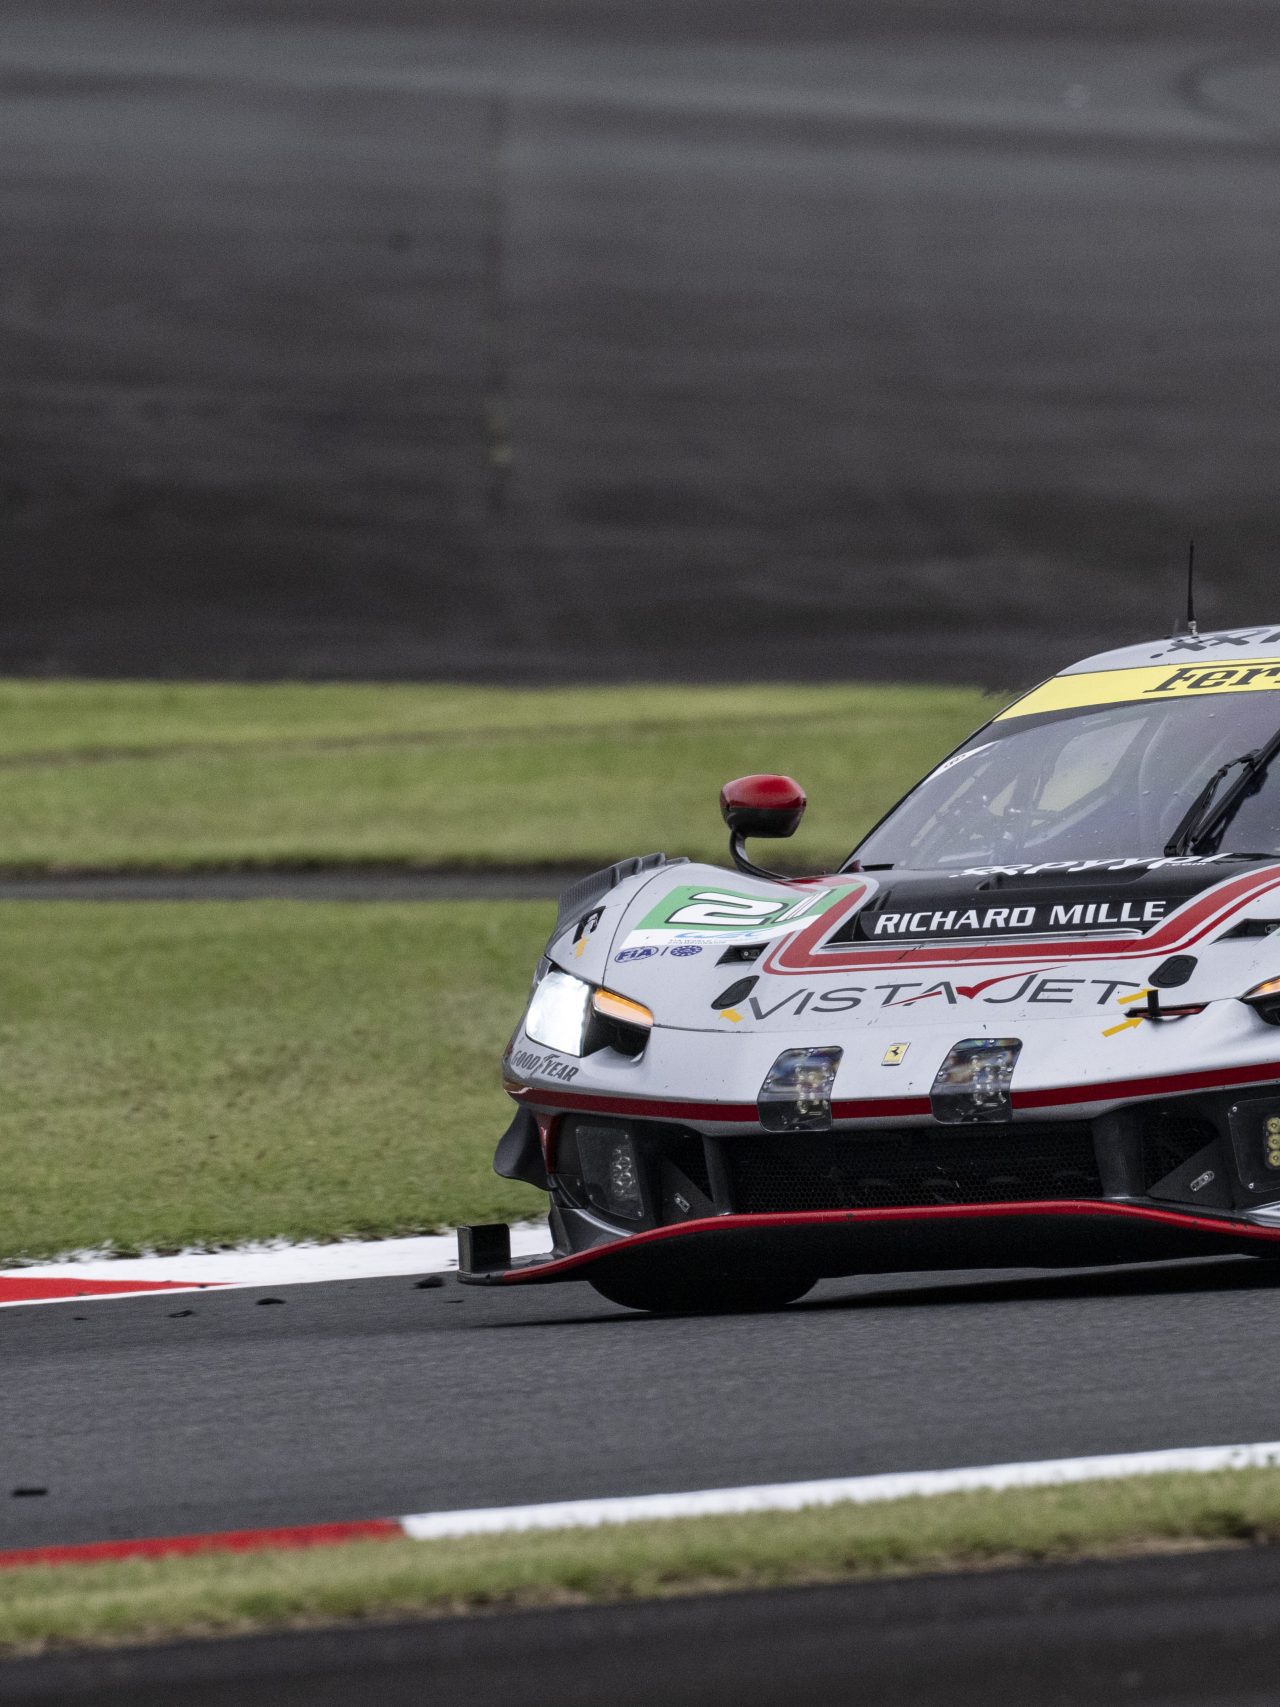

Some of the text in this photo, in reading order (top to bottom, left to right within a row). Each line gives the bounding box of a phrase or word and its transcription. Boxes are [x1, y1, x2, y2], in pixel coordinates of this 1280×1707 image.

[664, 889, 837, 926] 21
[874, 901, 1166, 935] RICHARD MILLE
[617, 948, 654, 961] FIA
